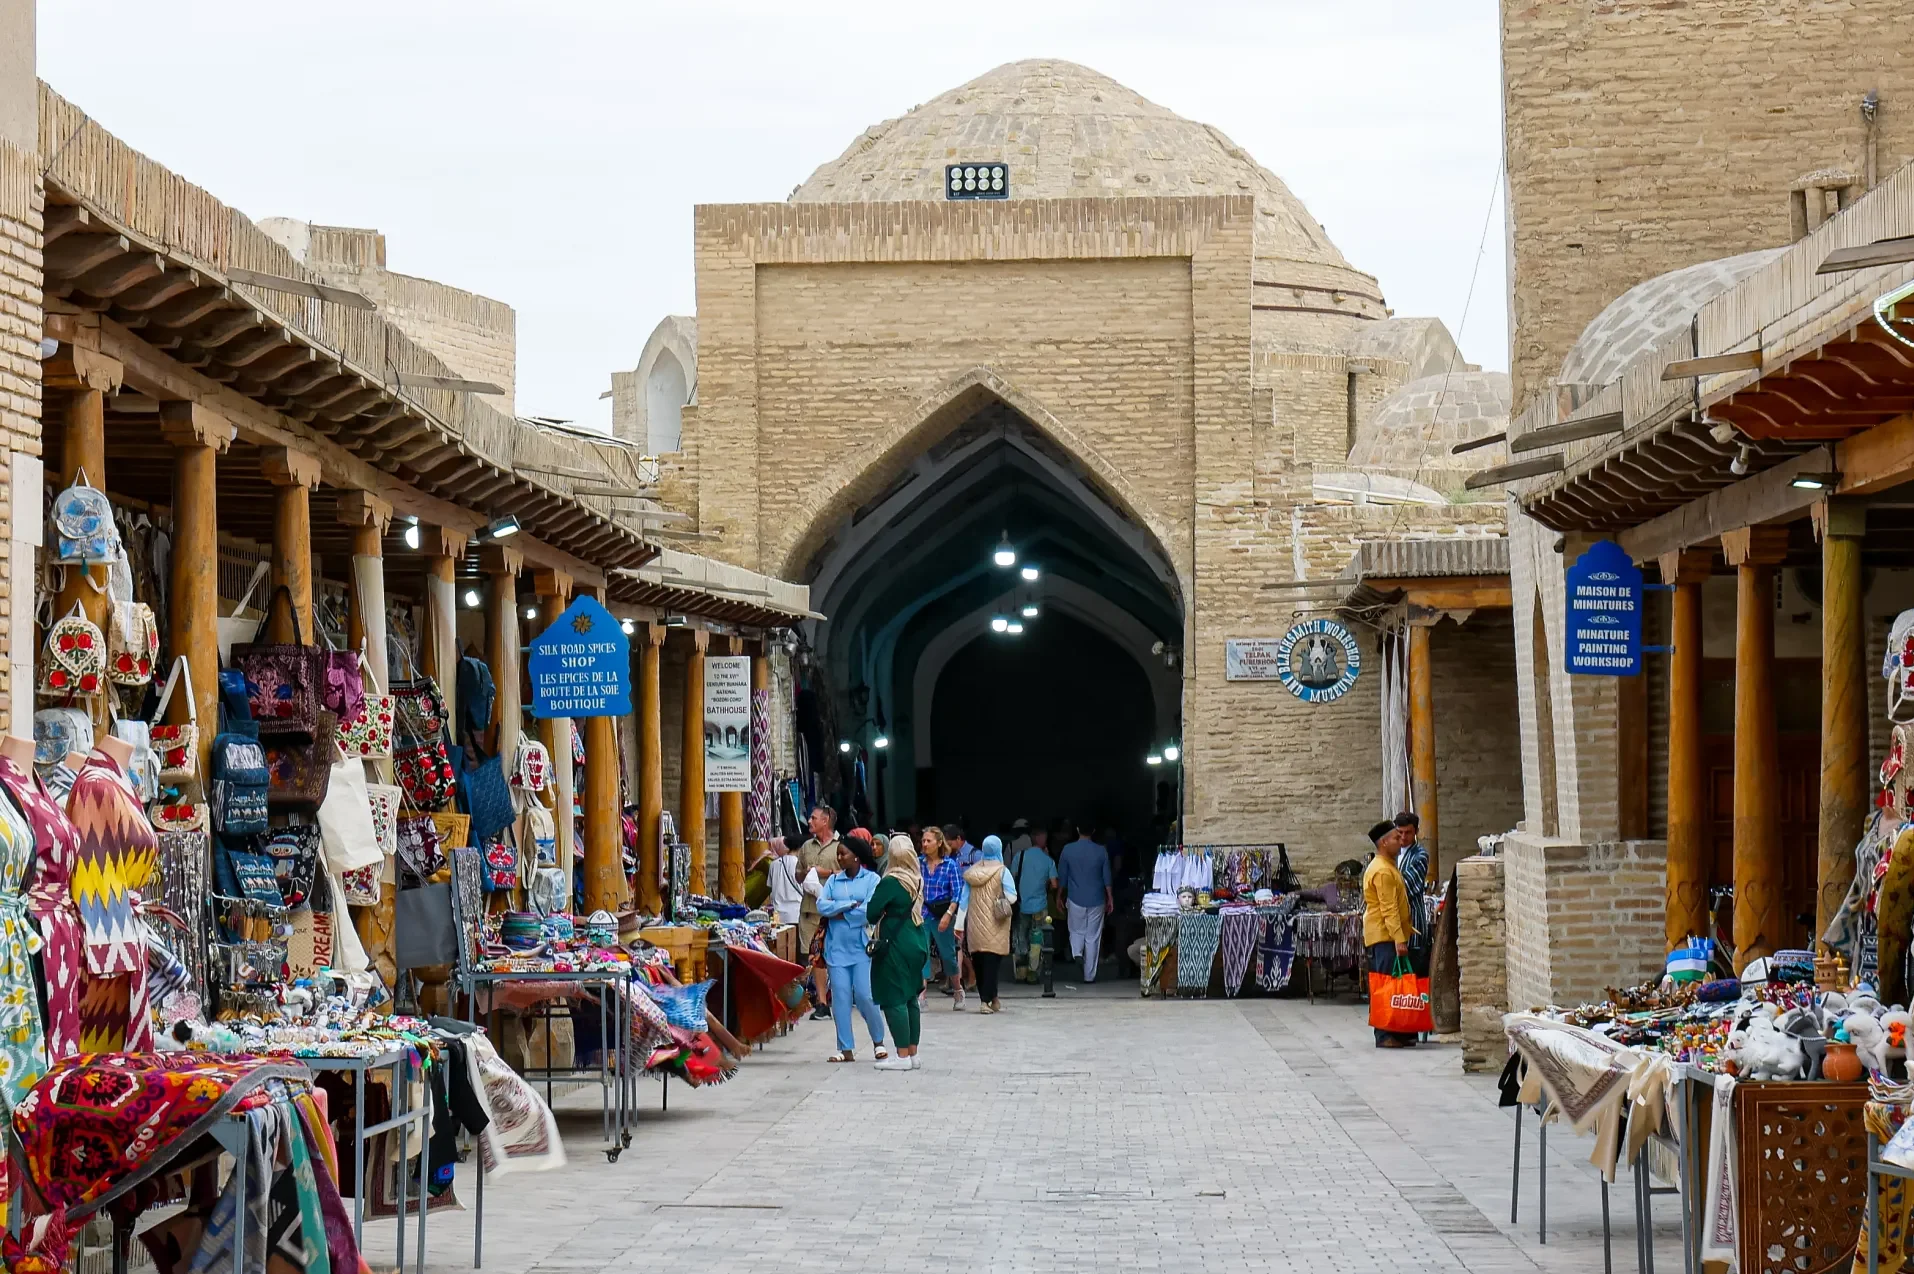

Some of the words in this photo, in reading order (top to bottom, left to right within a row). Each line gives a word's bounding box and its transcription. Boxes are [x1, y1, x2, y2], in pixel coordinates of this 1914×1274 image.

[1576, 586, 1616, 596] MAISON
[1618, 587, 1631, 597] DE
[1573, 600, 1634, 610] MINIATURES
[1577, 629, 1630, 640] MINATURE
[538, 644, 558, 656] SILK
[561, 644, 585, 655] ROAD
[588, 642, 616, 654] SPICES
[1578, 643, 1627, 654] PAINTING
[562, 656, 596, 668] SHOP
[1573, 656, 1634, 668] WORKSHOP
[540, 674, 556, 684] LES
[560, 672, 589, 684] EPICES
[592, 672, 604, 682] DE
[606, 671, 618, 682] LA
[540, 686, 570, 698] ROUTE
[573, 686, 585, 696] DE
[588, 686, 598, 696] LA
[600, 684, 620, 696] SOIE
[1282, 676, 1304, 696] AND
[1310, 672, 1356, 702] MUZEUM
[550, 698, 606, 710] BOUTIQUE
[706, 706, 747, 714] BATHHOUSE
[313, 910, 332, 966] DREAM
